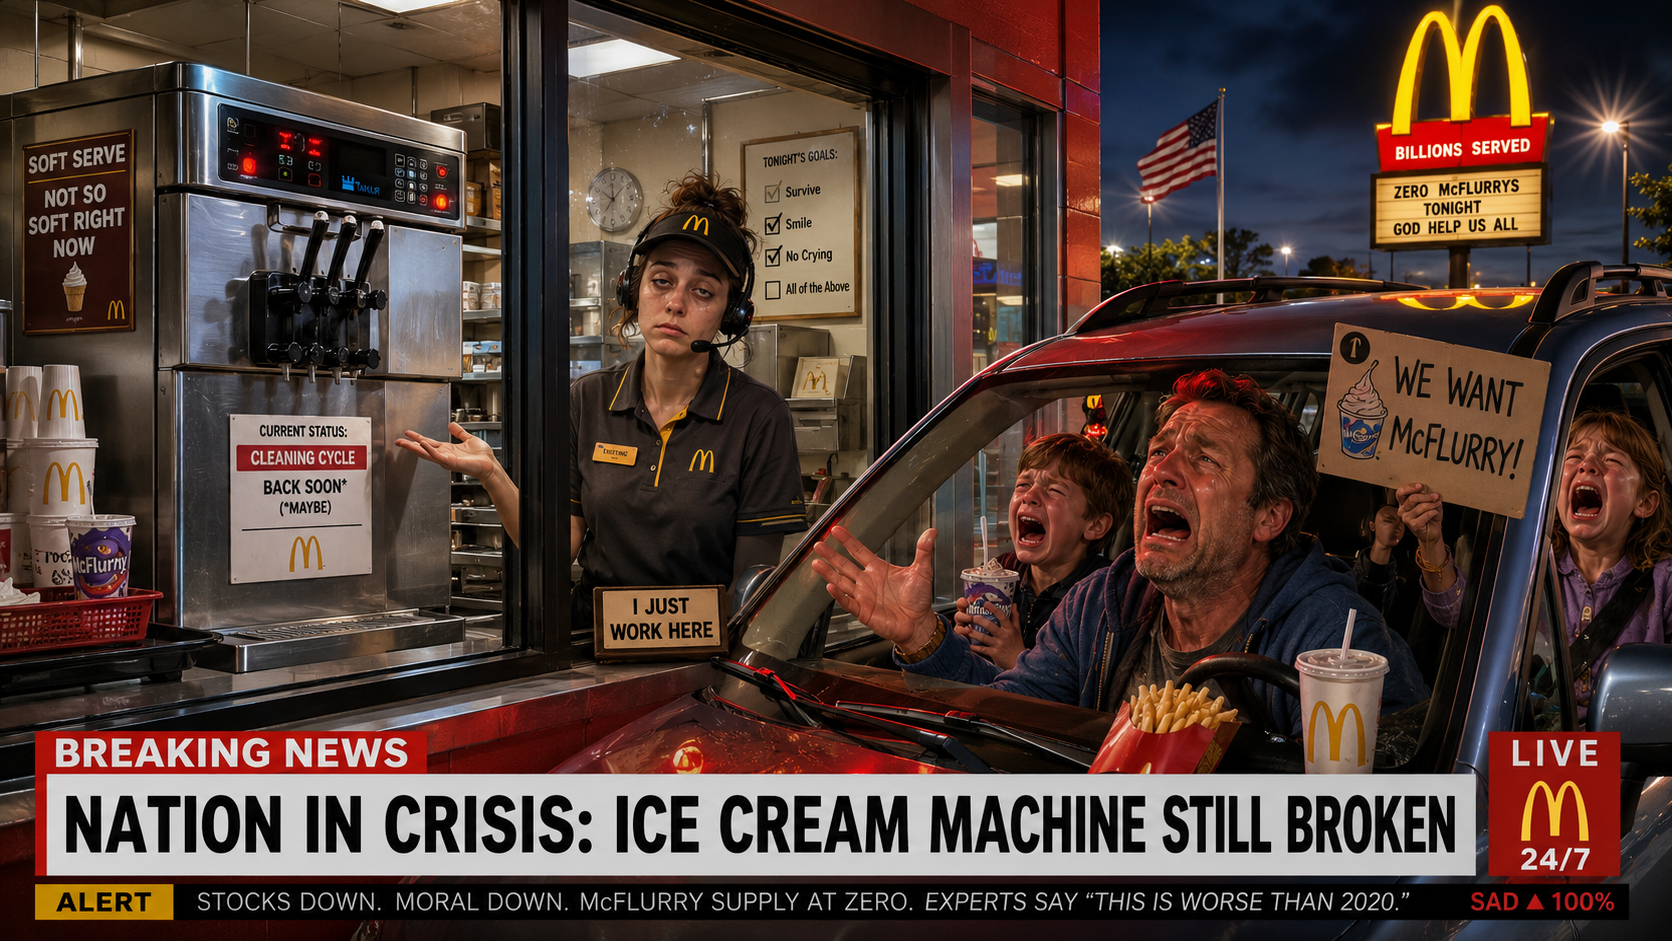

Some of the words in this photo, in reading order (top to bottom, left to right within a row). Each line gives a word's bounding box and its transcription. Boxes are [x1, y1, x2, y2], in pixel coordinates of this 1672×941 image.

[763, 151, 806, 168] TONIGHT'S
[808, 149, 838, 163] GOALS:
[1395, 142, 1462, 160] BILLIONS
[1471, 138, 1530, 155] SERVED
[28, 151, 68, 174] SOFT
[72, 144, 126, 169] SERVE
[44, 187, 78, 208] NOT
[83, 183, 106, 204] SO
[785, 184, 821, 198] Survive
[1394, 184, 1428, 199] ZERO
[1438, 179, 1519, 197] McFLURRYS
[1423, 200, 1481, 216] TONIGHT
[28, 213, 69, 235] SOFT
[73, 207, 125, 231] RIGHT
[785, 217, 812, 230] Smile
[1394, 222, 1420, 236] GOD
[1428, 220, 1461, 234] HELP
[1469, 218, 1486, 232] US
[1494, 217, 1518, 231] ALL
[53, 236, 96, 258] NOW
[786, 250, 799, 263] No
[801, 248, 833, 264] Crying
[785, 283, 797, 295] All
[798, 283, 808, 295] of
[809, 282, 823, 294] the
[824, 281, 850, 293] Above
[1395, 356, 1434, 398] WE
[1448, 366, 1524, 417] WANT
[259, 424, 306, 438] CURRENT
[308, 425, 348, 438] STATUS:
[1389, 415, 1524, 480] McFLURRY!
[250, 450, 315, 466] CLEANING
[318, 450, 355, 465] CYCLE
[263, 479, 301, 495] BACK
[632, 598, 638, 615] I
[645, 597, 689, 614] JUST
[610, 622, 663, 641] WORK
[669, 621, 714, 639] HERE
